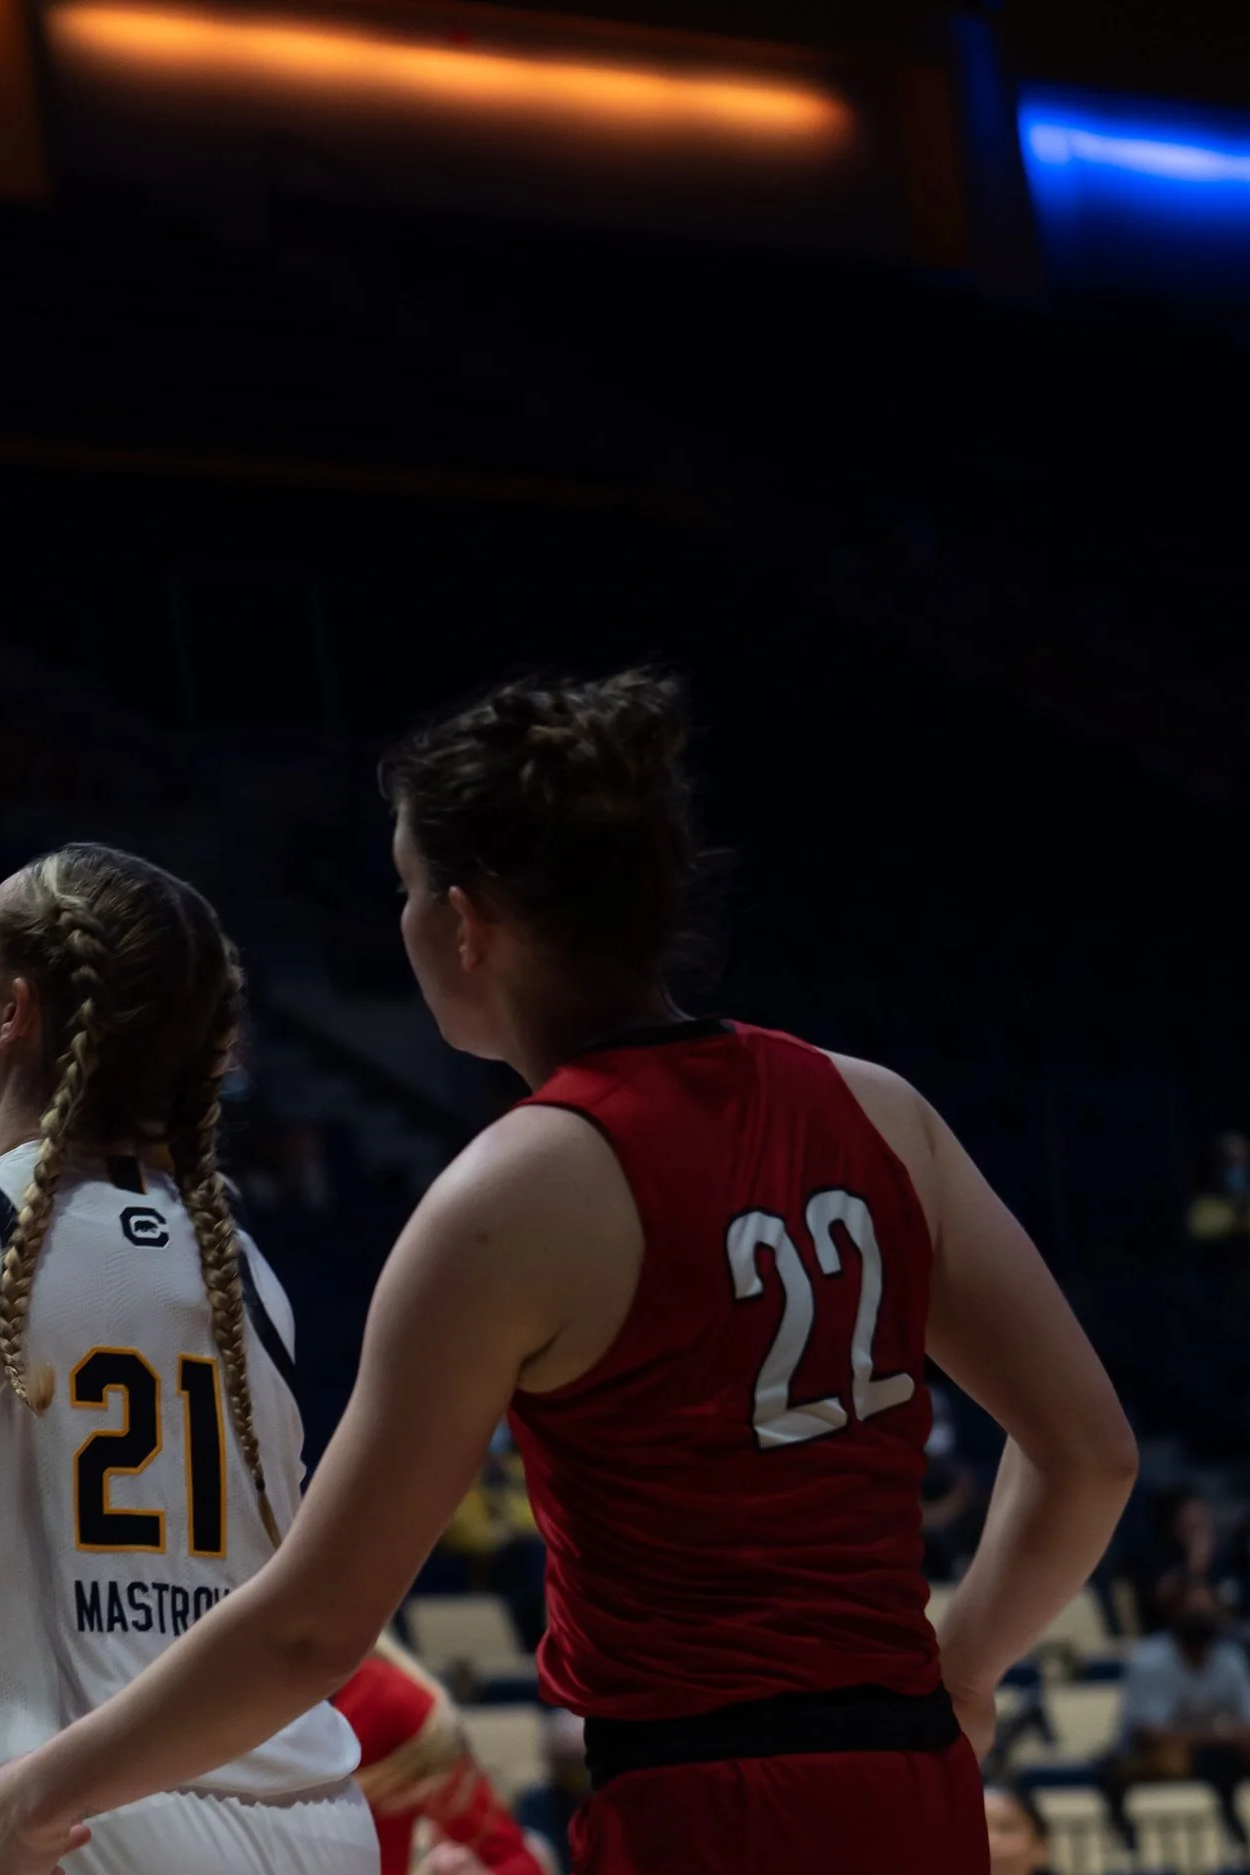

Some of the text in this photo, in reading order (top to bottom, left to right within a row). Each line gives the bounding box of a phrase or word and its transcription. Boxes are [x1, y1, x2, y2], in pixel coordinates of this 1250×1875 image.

[724, 1188, 916, 1450] 22
[69, 1346, 227, 1558] 21
[74, 1579, 232, 1637] MASTRO
